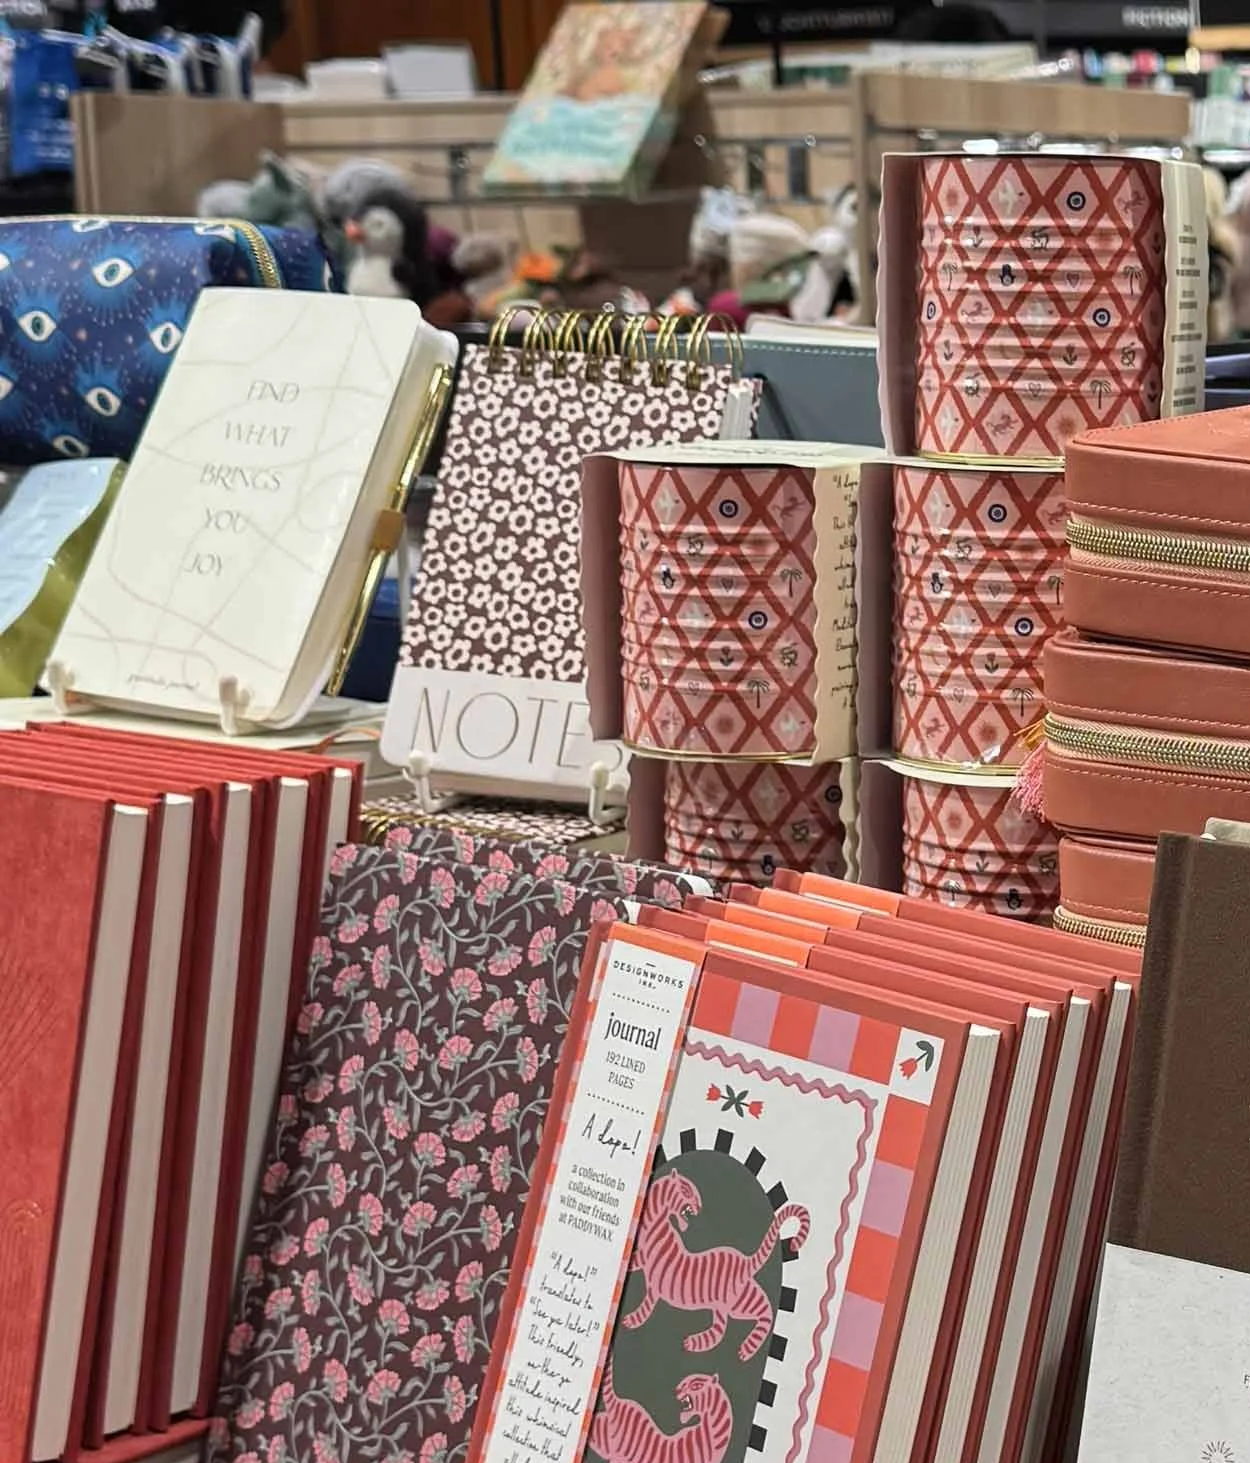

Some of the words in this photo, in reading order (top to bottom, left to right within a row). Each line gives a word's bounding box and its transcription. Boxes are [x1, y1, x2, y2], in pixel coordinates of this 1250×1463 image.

[410, 687, 623, 773] NOTE
[613, 960, 684, 989] DESIGNWORKS
[604, 1012, 661, 1050] journal
[606, 1051, 621, 1065] 192
[621, 1057, 646, 1073] LINED
[608, 1071, 635, 1089] PAGES
[582, 1113, 596, 1139] A
[578, 1166, 617, 1188] collection
[617, 1178, 625, 1192] in
[568, 1180, 619, 1207] collaboration
[560, 1194, 577, 1209] with
[578, 1201, 591, 1214] our
[591, 1203, 620, 1227] friends
[558, 1212, 566, 1224] at
[568, 1214, 614, 1242] PADDYWAX
